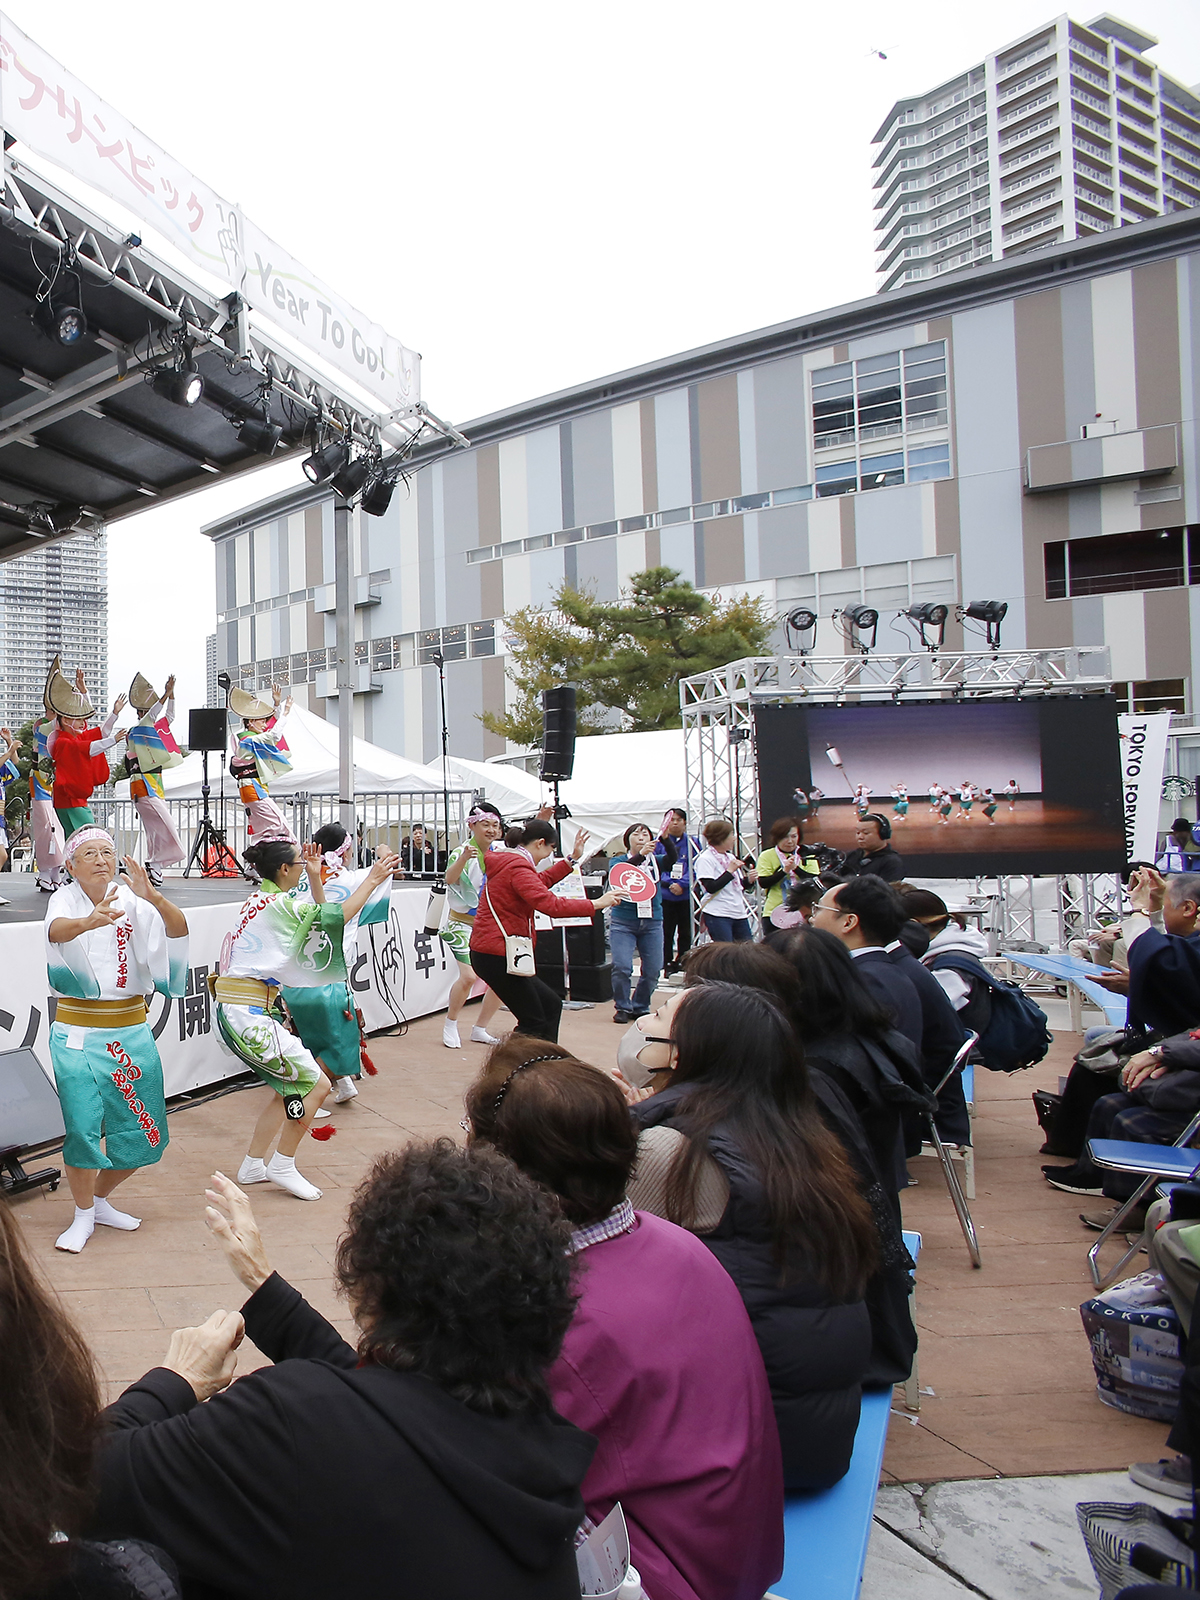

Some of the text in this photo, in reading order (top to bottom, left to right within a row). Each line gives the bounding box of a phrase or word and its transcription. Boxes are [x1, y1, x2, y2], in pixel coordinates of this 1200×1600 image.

[254, 251, 309, 326] Year
[316, 299, 345, 349] To
[351, 327, 385, 381] Go!
[1126, 724, 1147, 777] TOKYO
[1090, 1302, 1170, 1329] TOKYO
